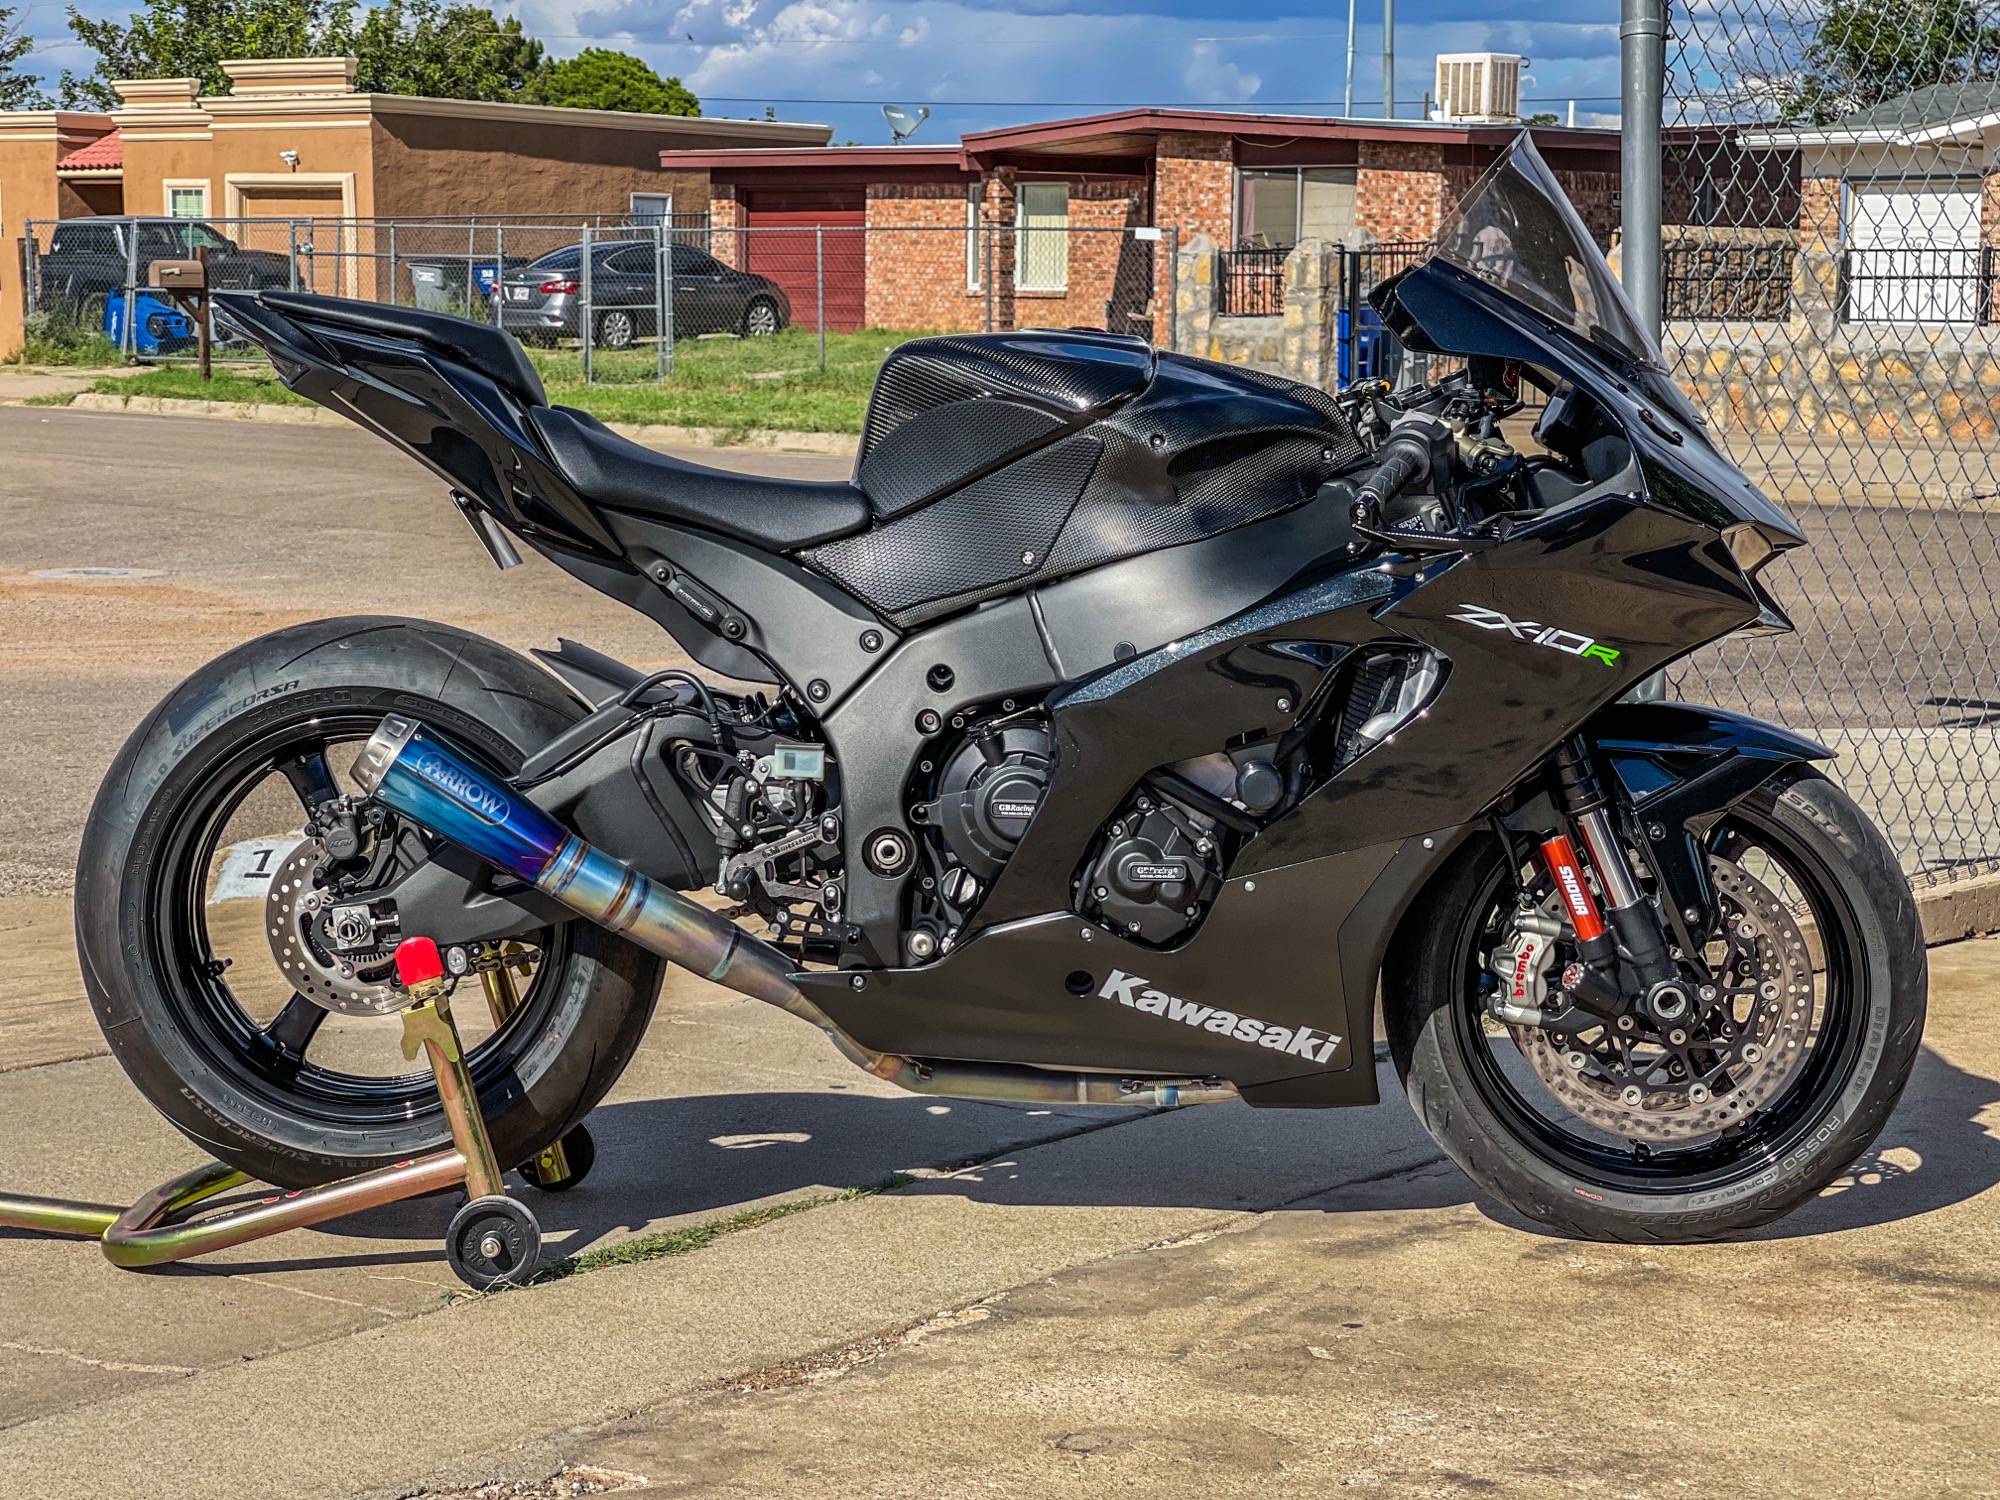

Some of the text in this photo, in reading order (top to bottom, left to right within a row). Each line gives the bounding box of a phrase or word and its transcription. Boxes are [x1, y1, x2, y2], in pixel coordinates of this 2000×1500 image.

[1445, 604, 1620, 667] ZX-10R
[173, 680, 300, 760] SUPERCORSA
[424, 756, 506, 815] ARROW
[1558, 865, 1589, 916] SHOWA
[1513, 944, 1535, 998] brembo
[1098, 968, 1342, 1064] Kawasaki
[1853, 1006, 1887, 1092] DIABLO
[181, 1087, 314, 1164] SUPERCORSA
[1783, 1115, 1841, 1172] ROSSO
